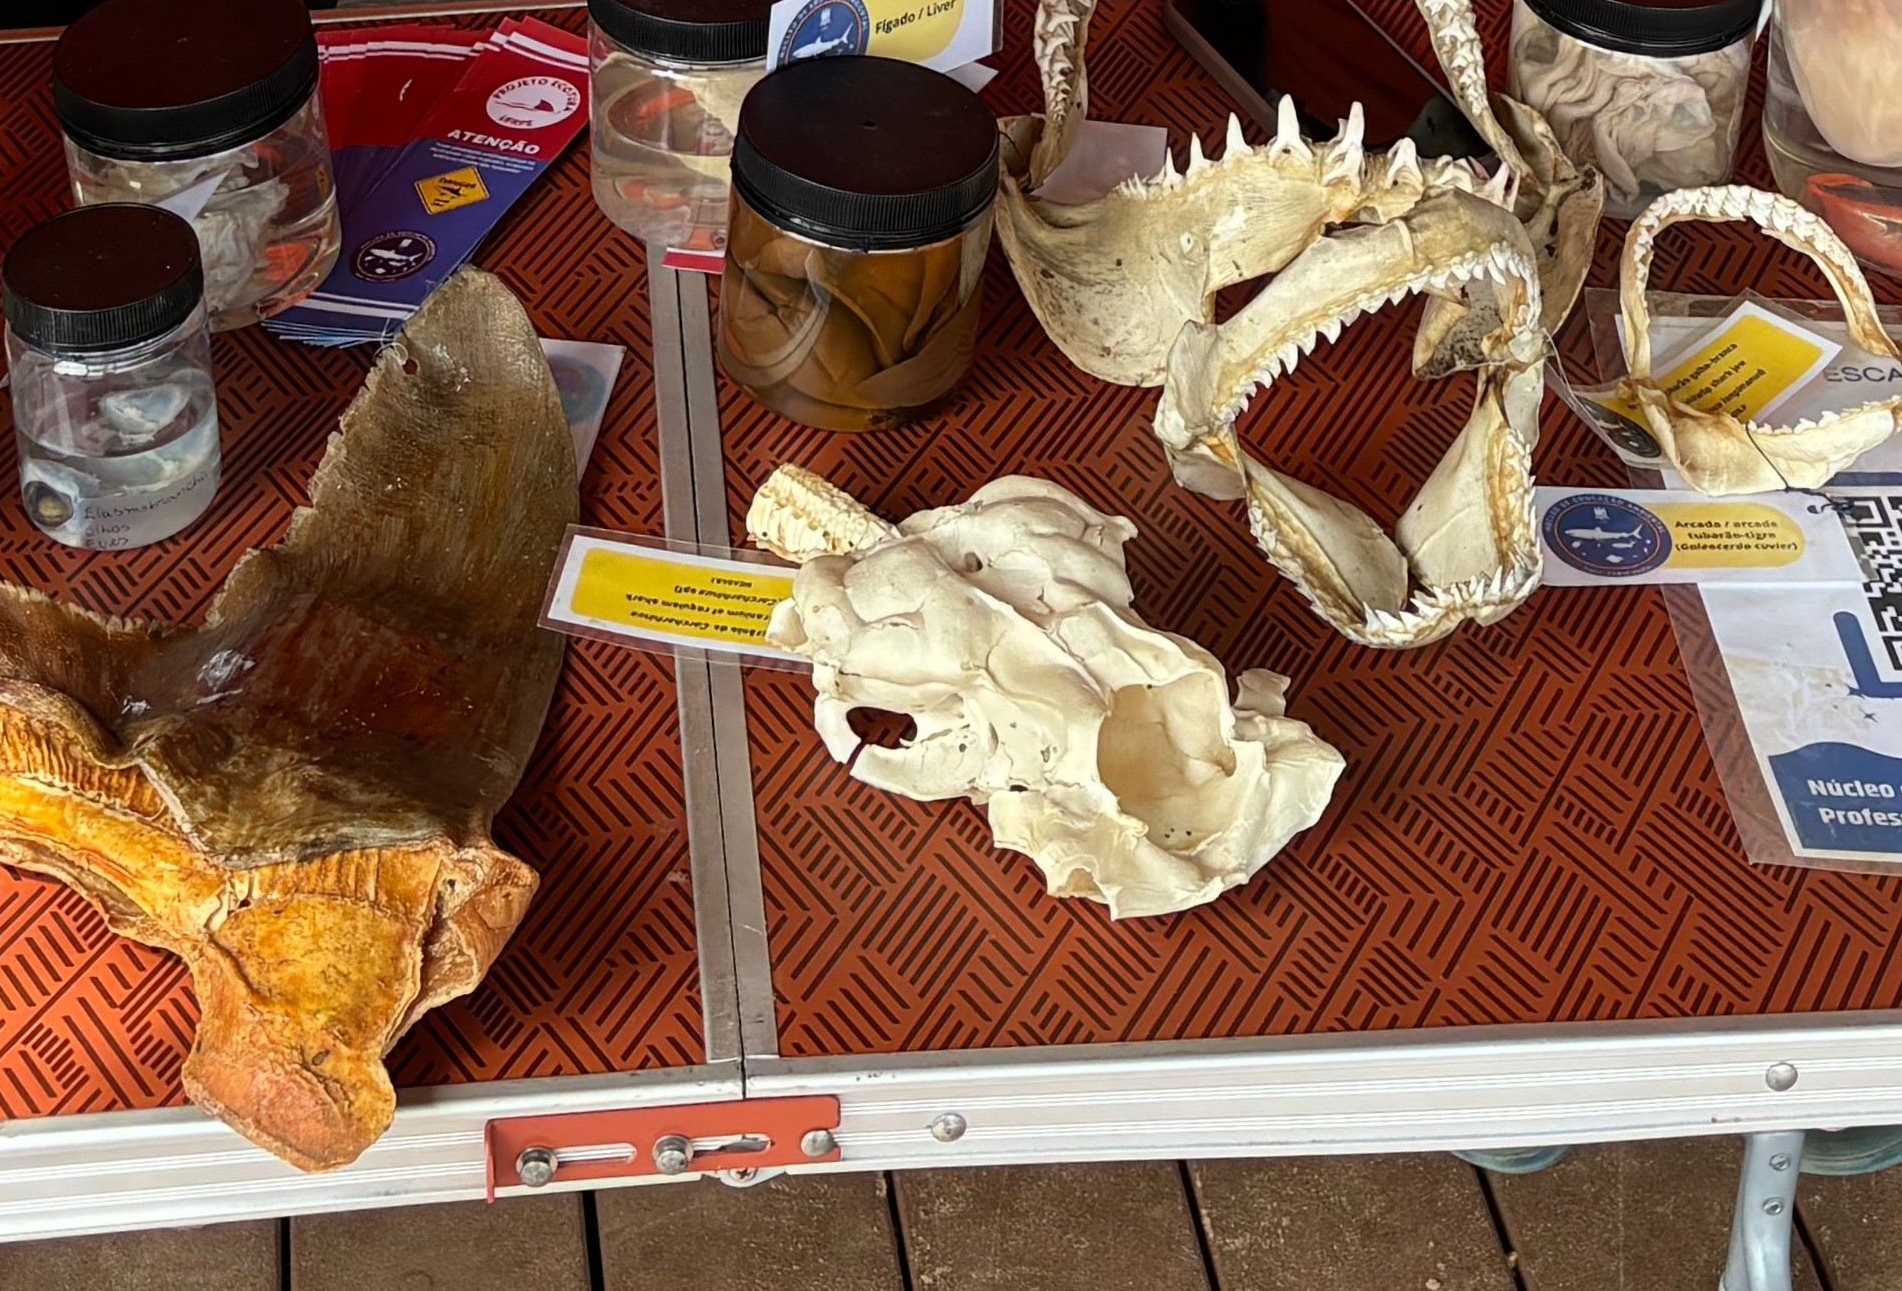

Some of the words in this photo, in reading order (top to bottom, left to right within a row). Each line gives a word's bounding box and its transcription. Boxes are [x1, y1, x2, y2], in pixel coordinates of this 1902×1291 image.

[875, 12, 915, 34] Fígado
[492, 78, 549, 100] PROJETO
[447, 129, 541, 155] ATENÇÃO
[727, 608, 769, 622] ranium
[730, 624, 767, 638] rânio
[1806, 778, 1896, 800] Núcleo
